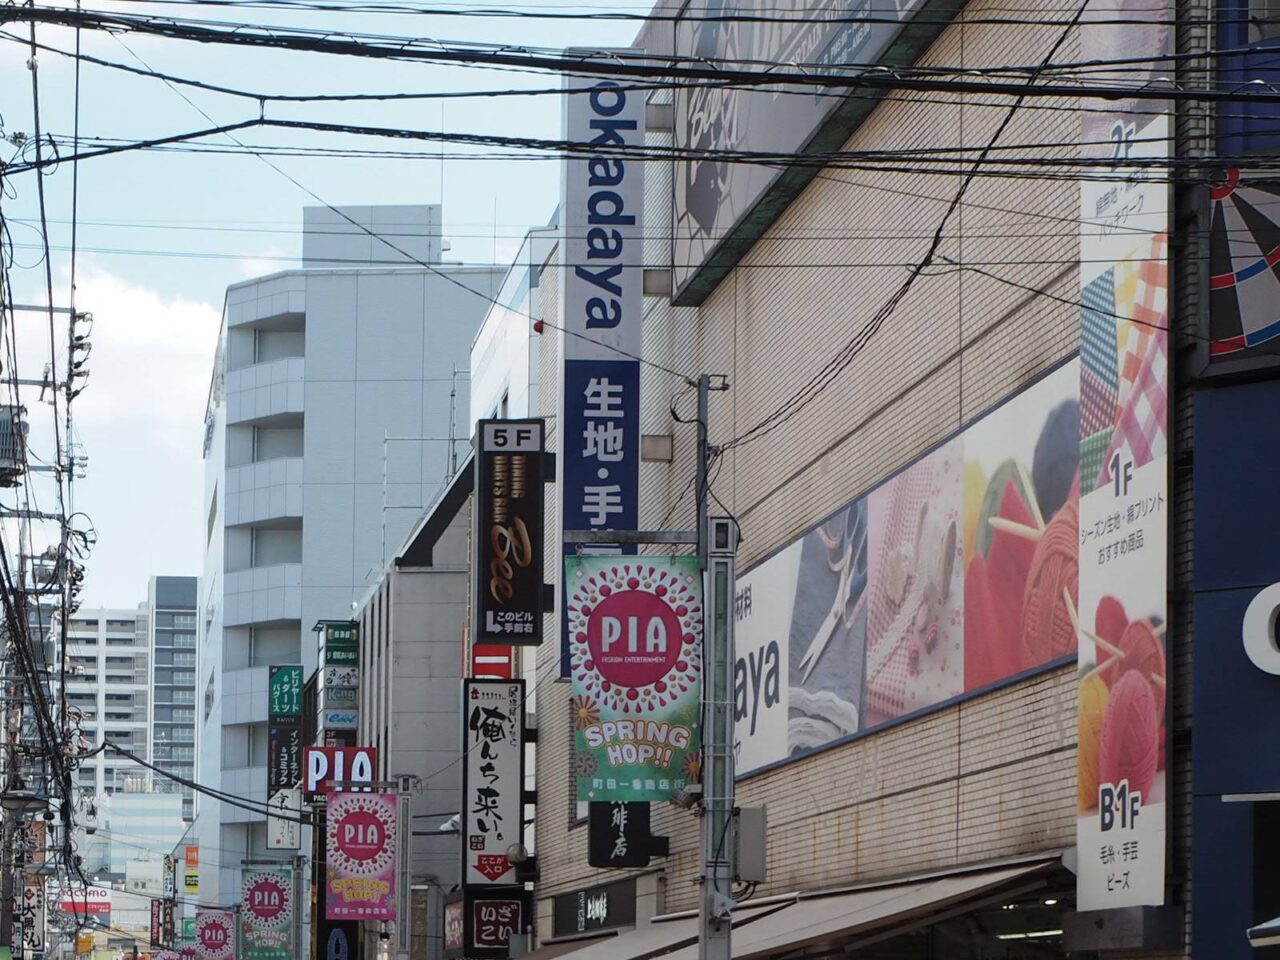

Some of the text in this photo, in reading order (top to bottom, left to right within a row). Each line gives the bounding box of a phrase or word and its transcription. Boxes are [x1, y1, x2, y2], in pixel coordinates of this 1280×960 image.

[575, 82, 638, 331] okadaya
[1110, 453, 1133, 498] 1F
[1097, 529, 1144, 565] おすすめ商品
[496, 611, 533, 622] このビル
[503, 623, 534, 634] 手前右
[601, 615, 667, 653] PIA
[291, 669, 300, 713] ビリヤード
[584, 719, 691, 750] SPRING
[290, 729, 298, 785] インターネット
[606, 743, 673, 768] HOP!!
[307, 750, 373, 792] PIA
[592, 778, 685, 791] 町田一番商店街
[1101, 784, 1140, 832] B1F
[344, 824, 379, 844] PIA
[609, 800, 628, 861] 琲店
[480, 857, 504, 865] ここが
[1100, 841, 1139, 865] 毛糸・手芸
[484, 866, 503, 874] 入口
[254, 891, 279, 906] PIA
[204, 928, 224, 942] PIA
[245, 930, 288, 942] SPRING
